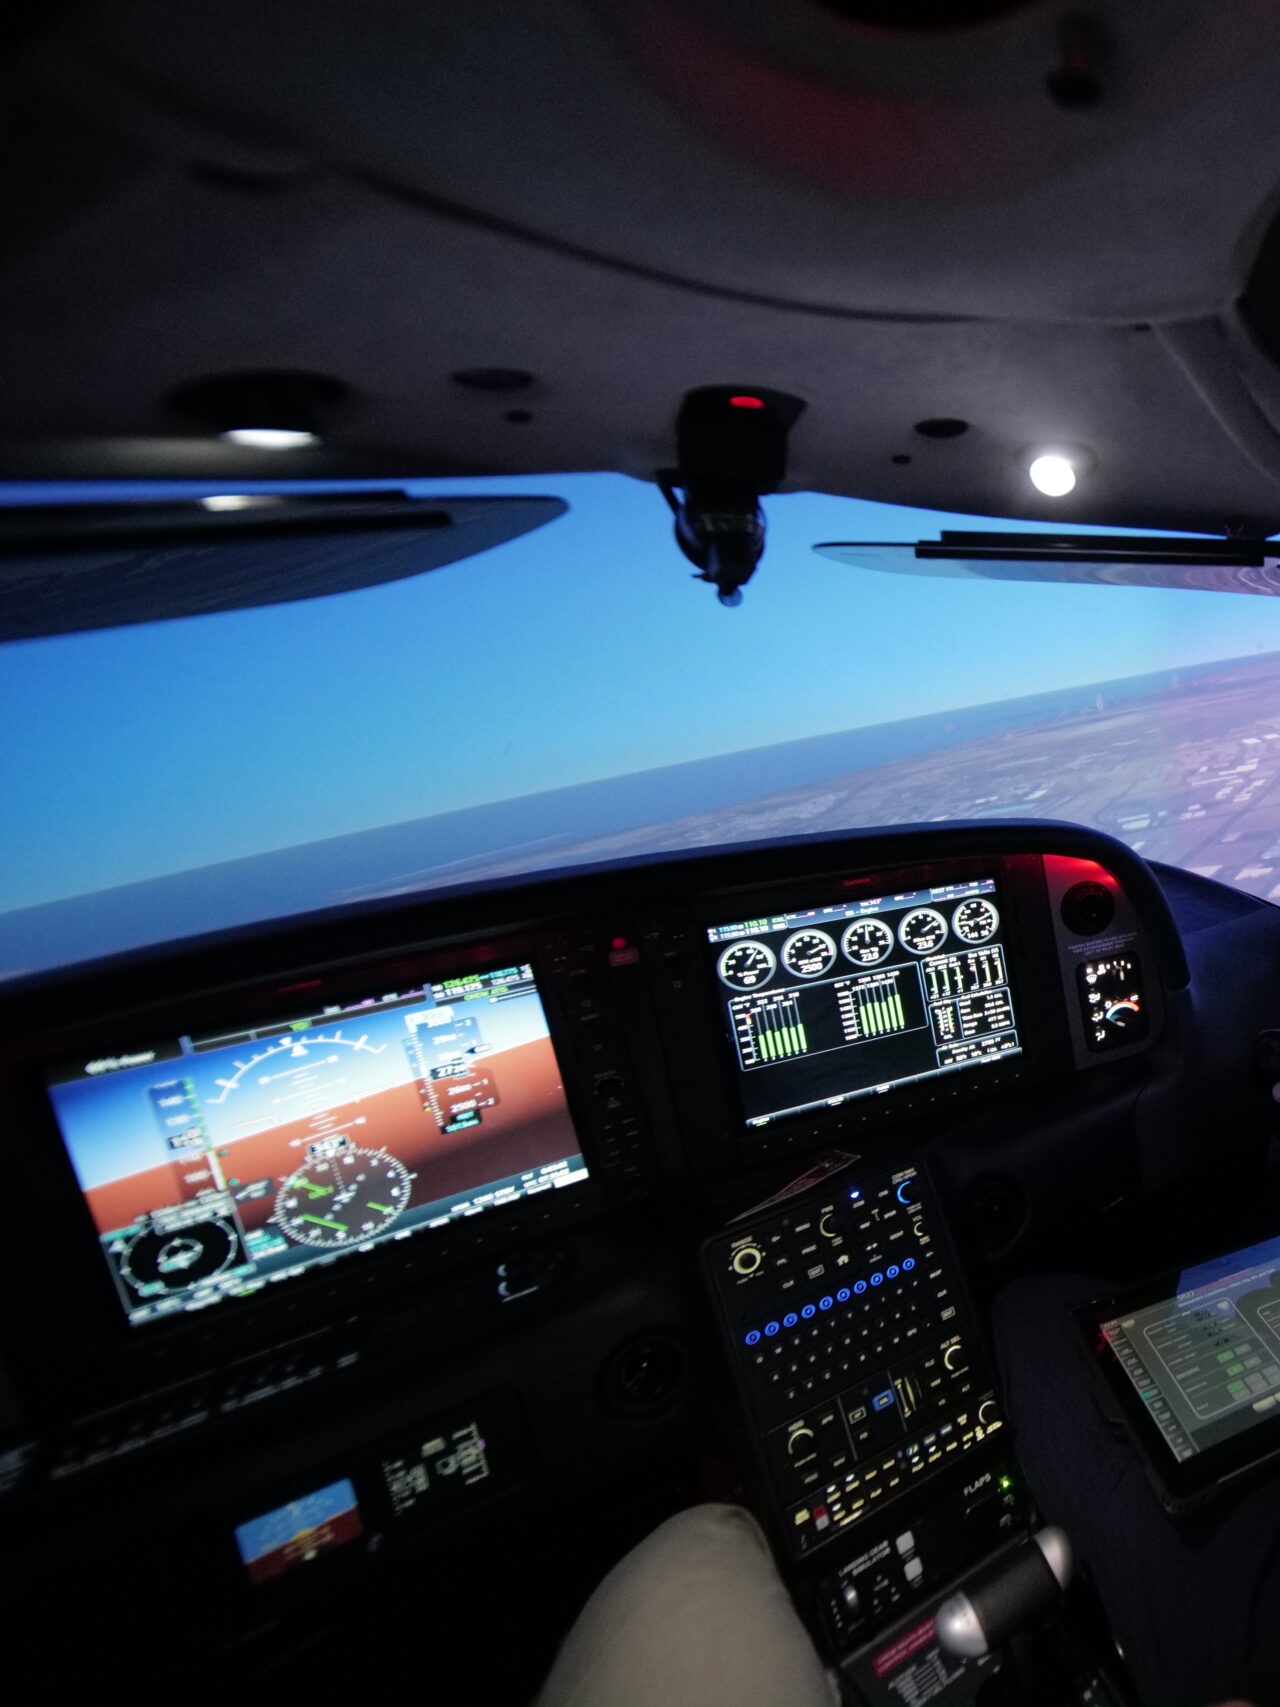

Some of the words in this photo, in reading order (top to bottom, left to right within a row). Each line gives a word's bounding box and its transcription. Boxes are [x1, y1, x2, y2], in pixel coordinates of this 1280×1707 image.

[916, 940, 934, 950] 23.6
[800, 963, 823, 974] 2500
[963, 1472, 992, 1497] FLAPS
